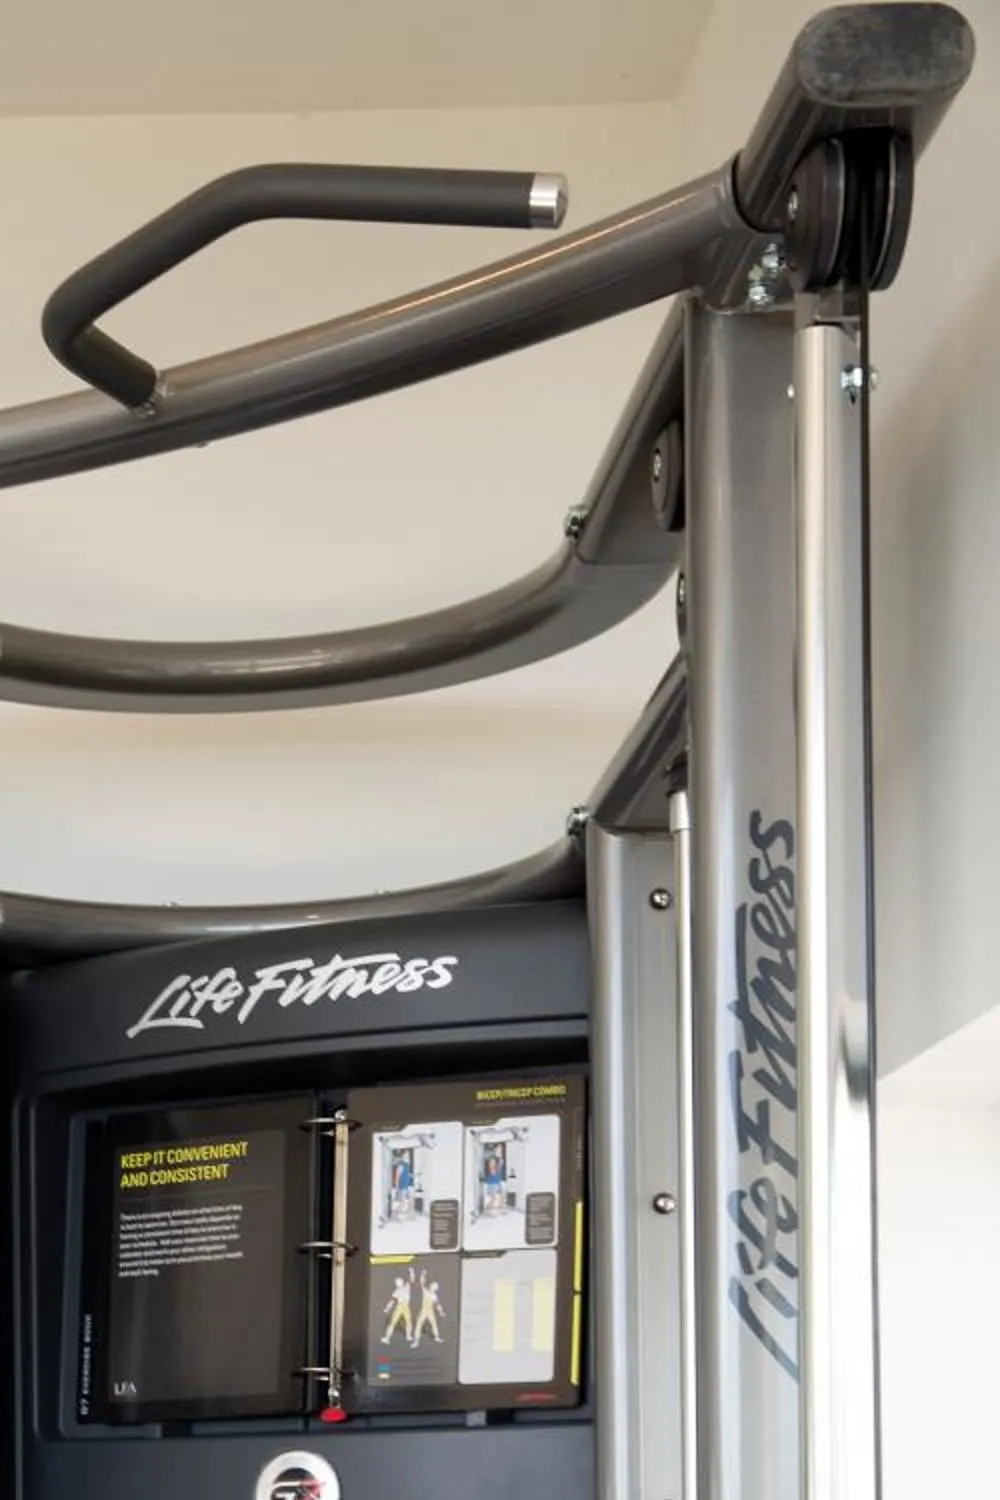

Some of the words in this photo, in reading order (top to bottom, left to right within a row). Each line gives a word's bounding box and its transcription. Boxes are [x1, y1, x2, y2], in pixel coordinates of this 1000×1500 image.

[125, 967, 244, 1039] Life
[237, 953, 458, 1025] Fitness
[121, 1151, 152, 1169] KEEP
[153, 1150, 166, 1165] IT
[166, 1141, 248, 1164] CONVENIENT
[121, 1171, 148, 1188] AND
[149, 1163, 229, 1185] CONSISTENT
